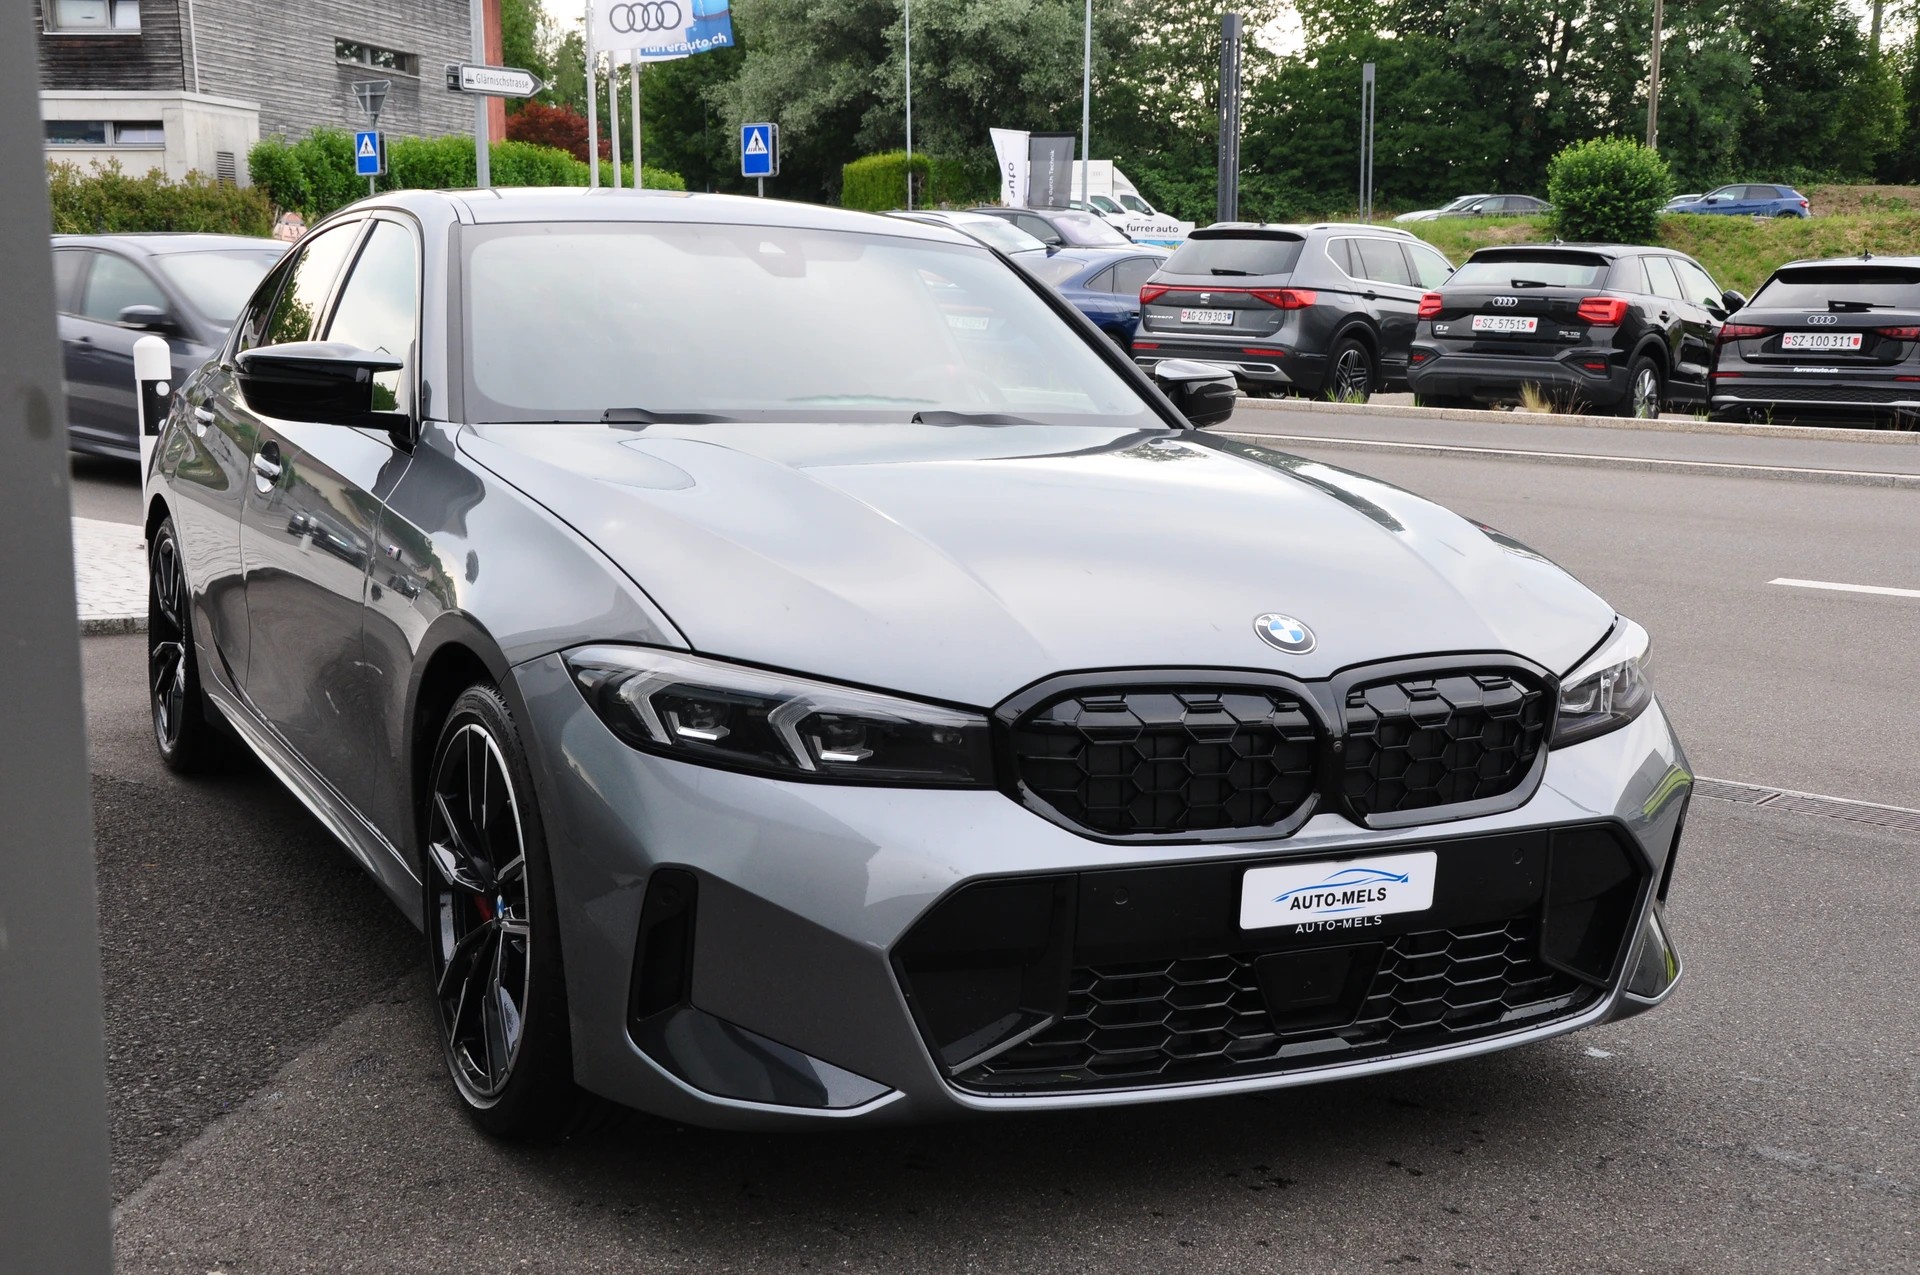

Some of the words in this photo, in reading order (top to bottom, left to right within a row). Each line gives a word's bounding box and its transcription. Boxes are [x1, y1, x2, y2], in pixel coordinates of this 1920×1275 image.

[475, 73, 529, 89] Glärnischstrasse
[1126, 223, 1154, 233] furrer
[1156, 225, 1179, 233] auto
[1290, 887, 1387, 910] AUTO-MELS
[1295, 915, 1382, 934] AUTO-MELS
